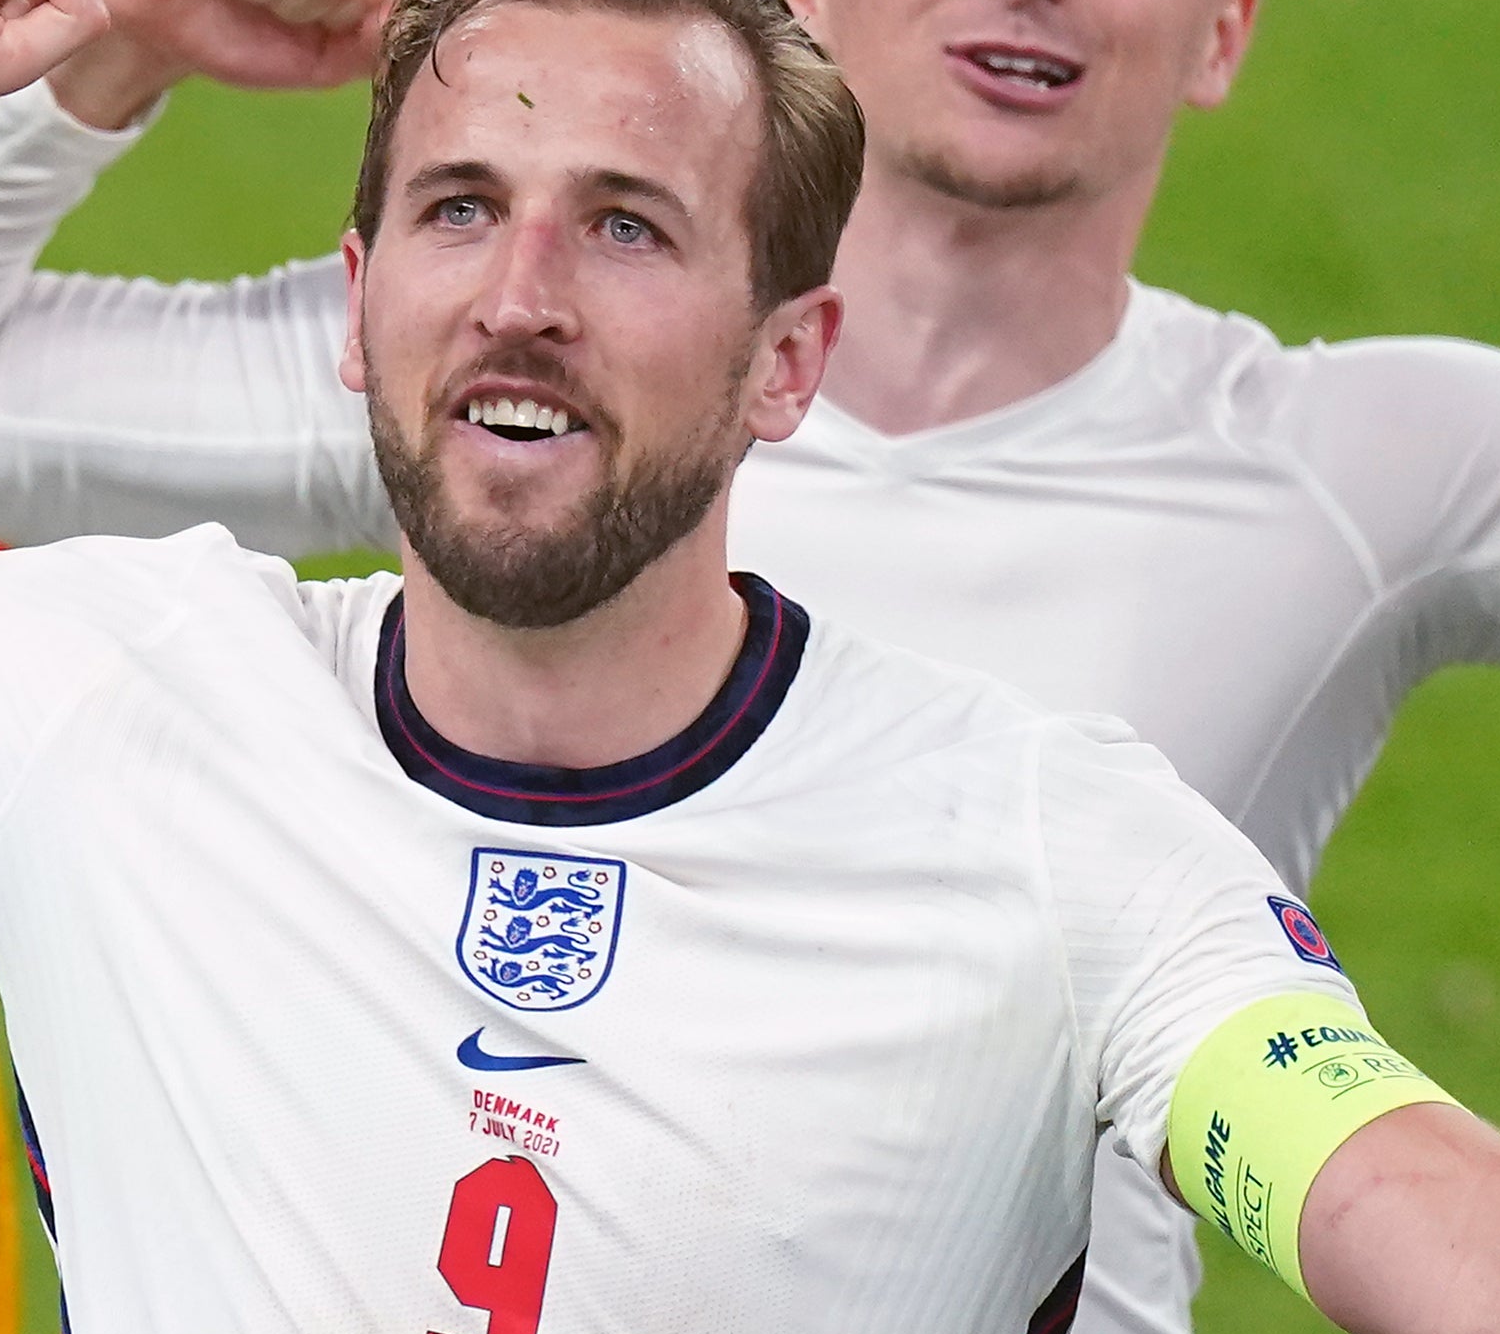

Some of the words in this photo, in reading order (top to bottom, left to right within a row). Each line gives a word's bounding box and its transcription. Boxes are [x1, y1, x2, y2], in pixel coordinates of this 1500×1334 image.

[469, 1111, 478, 1132] 7
[482, 1117, 516, 1144] JULY
[522, 1129, 560, 1157] 2021
[473, 1089, 561, 1134] DENMARK
